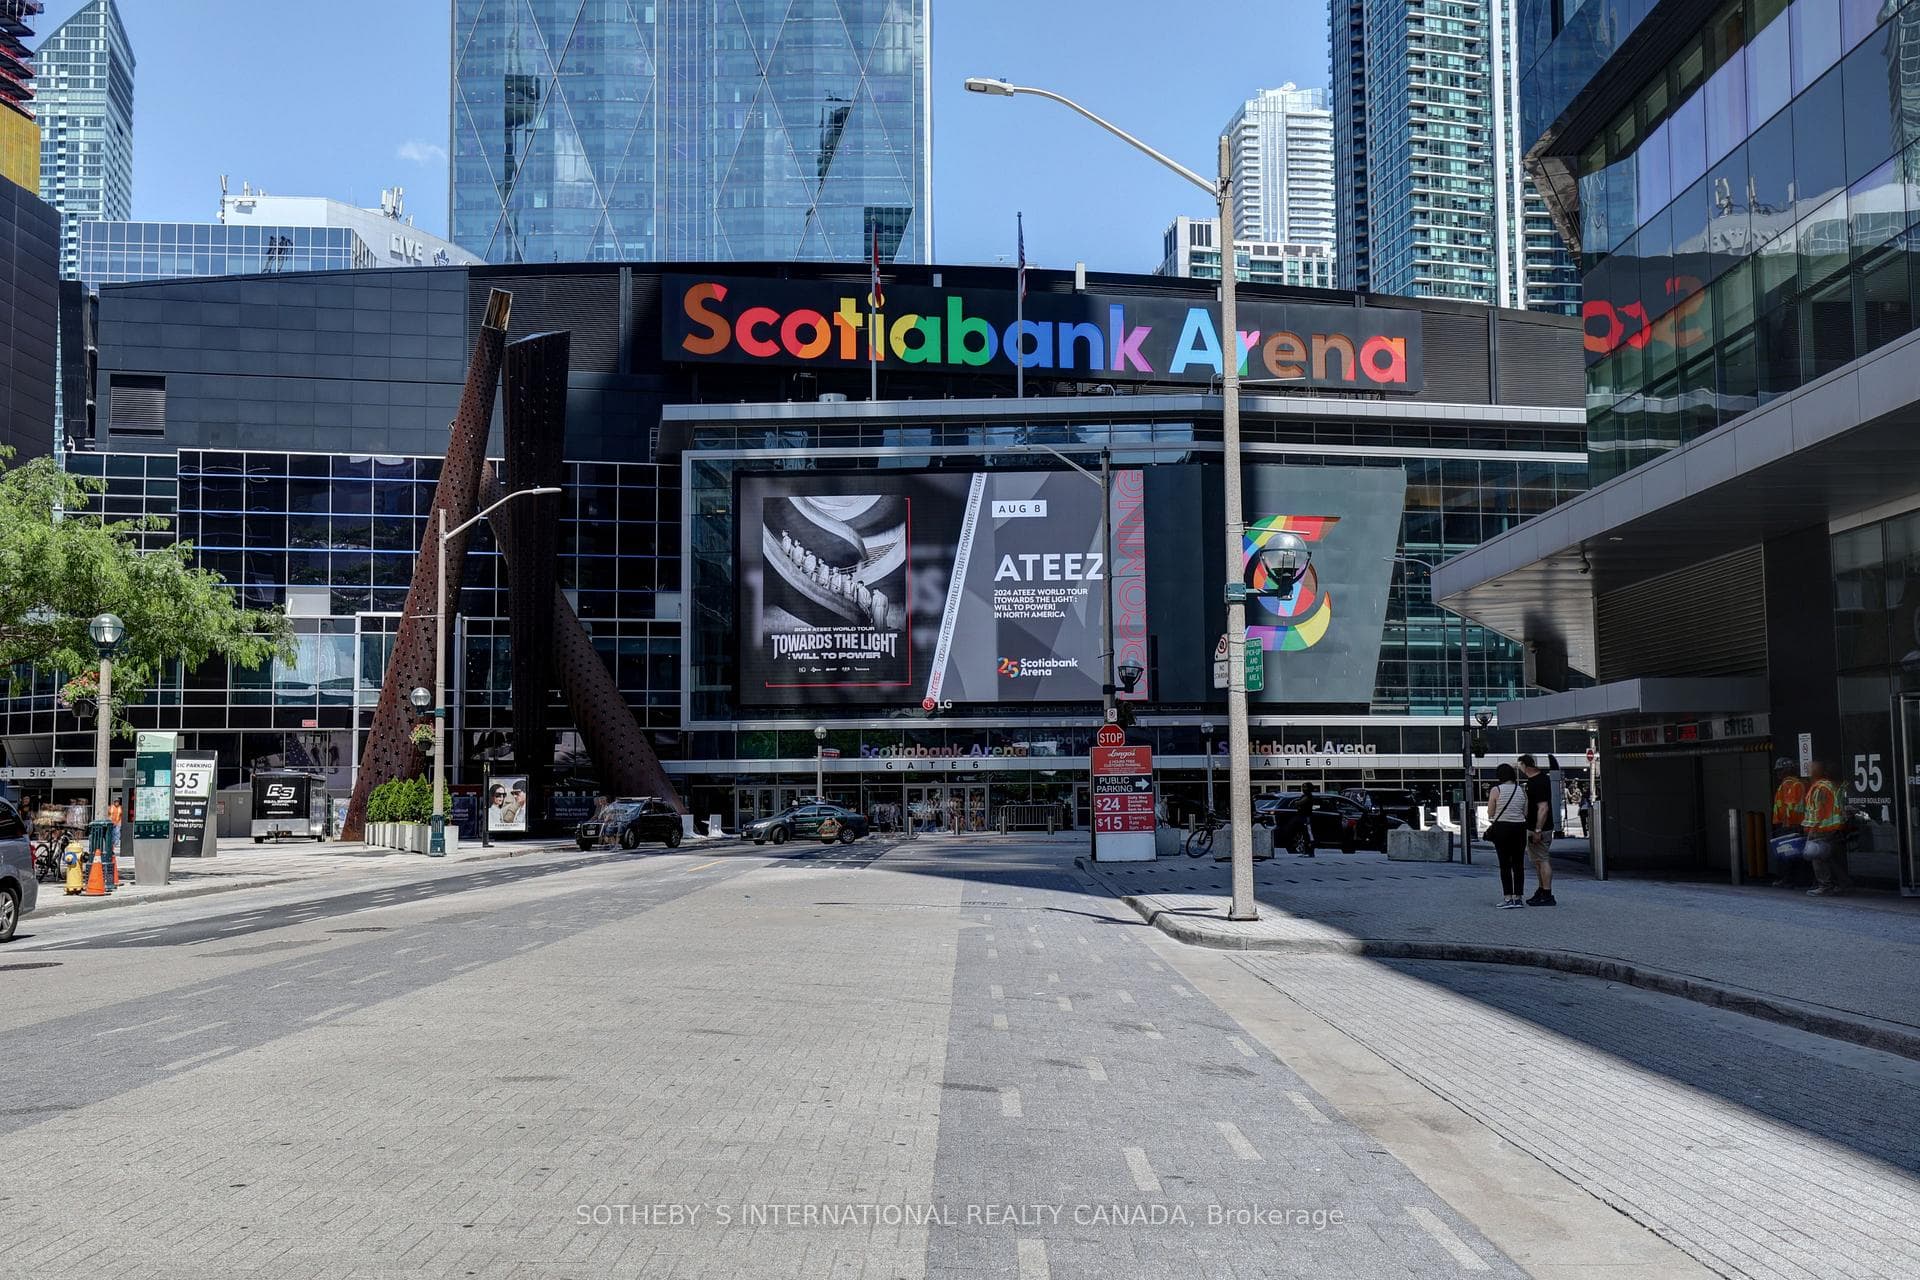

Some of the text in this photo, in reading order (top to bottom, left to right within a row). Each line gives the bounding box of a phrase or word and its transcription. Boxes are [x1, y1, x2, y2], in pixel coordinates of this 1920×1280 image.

[681, 283, 1408, 383] Scotiabank Arena
[998, 504, 1041, 514] AUG 8
[993, 553, 1104, 581] ATEEZ
[1037, 588, 1066, 596] WORLD
[771, 633, 898, 659] TOWARDS THE LIGHT
[791, 652, 820, 660] WILL
[821, 652, 837, 660] TO
[1020, 658, 1079, 668] Scotiabank
[1020, 668, 1052, 676] Arena
[938, 699, 952, 709] LG
[1100, 733, 1123, 743] STOP
[861, 743, 1027, 758] Scotiabank Arena
[1218, 741, 1377, 755] Stiabank Arena
[886, 761, 979, 770] GATE 6
[1264, 758, 1332, 767] ATE 6
[1854, 753, 1883, 792] 55
[174, 772, 199, 789] 35
[1099, 776, 1130, 785] PUBLIC
[1096, 785, 1133, 793] PARKING
[1096, 797, 1121, 811] $24
[1098, 816, 1123, 830] $15
